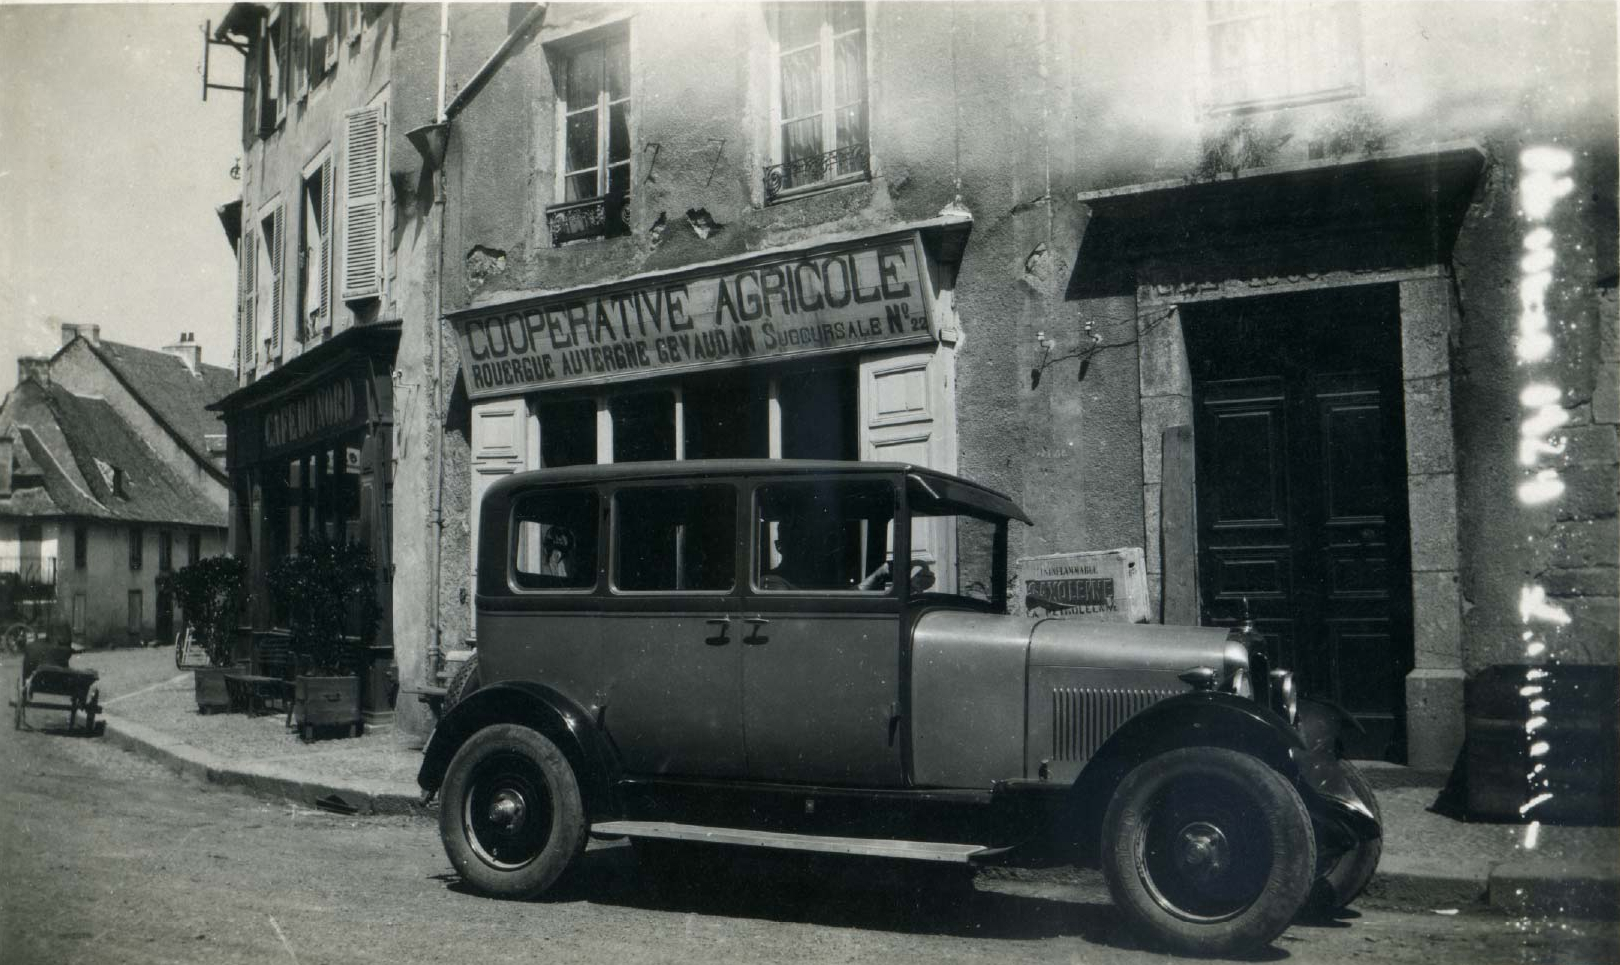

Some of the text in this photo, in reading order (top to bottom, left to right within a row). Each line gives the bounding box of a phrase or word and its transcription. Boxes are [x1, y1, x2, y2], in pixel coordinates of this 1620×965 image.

[465, 245, 911, 361] COOPERATIVE AGRICOLE
[472, 353, 555, 389] ROUERGUE
[562, 341, 650, 376] AUVERGNE
[657, 325, 756, 364] GEVAUDAN
[911, 316, 928, 331] 22
[316, 378, 355, 430] NORD
